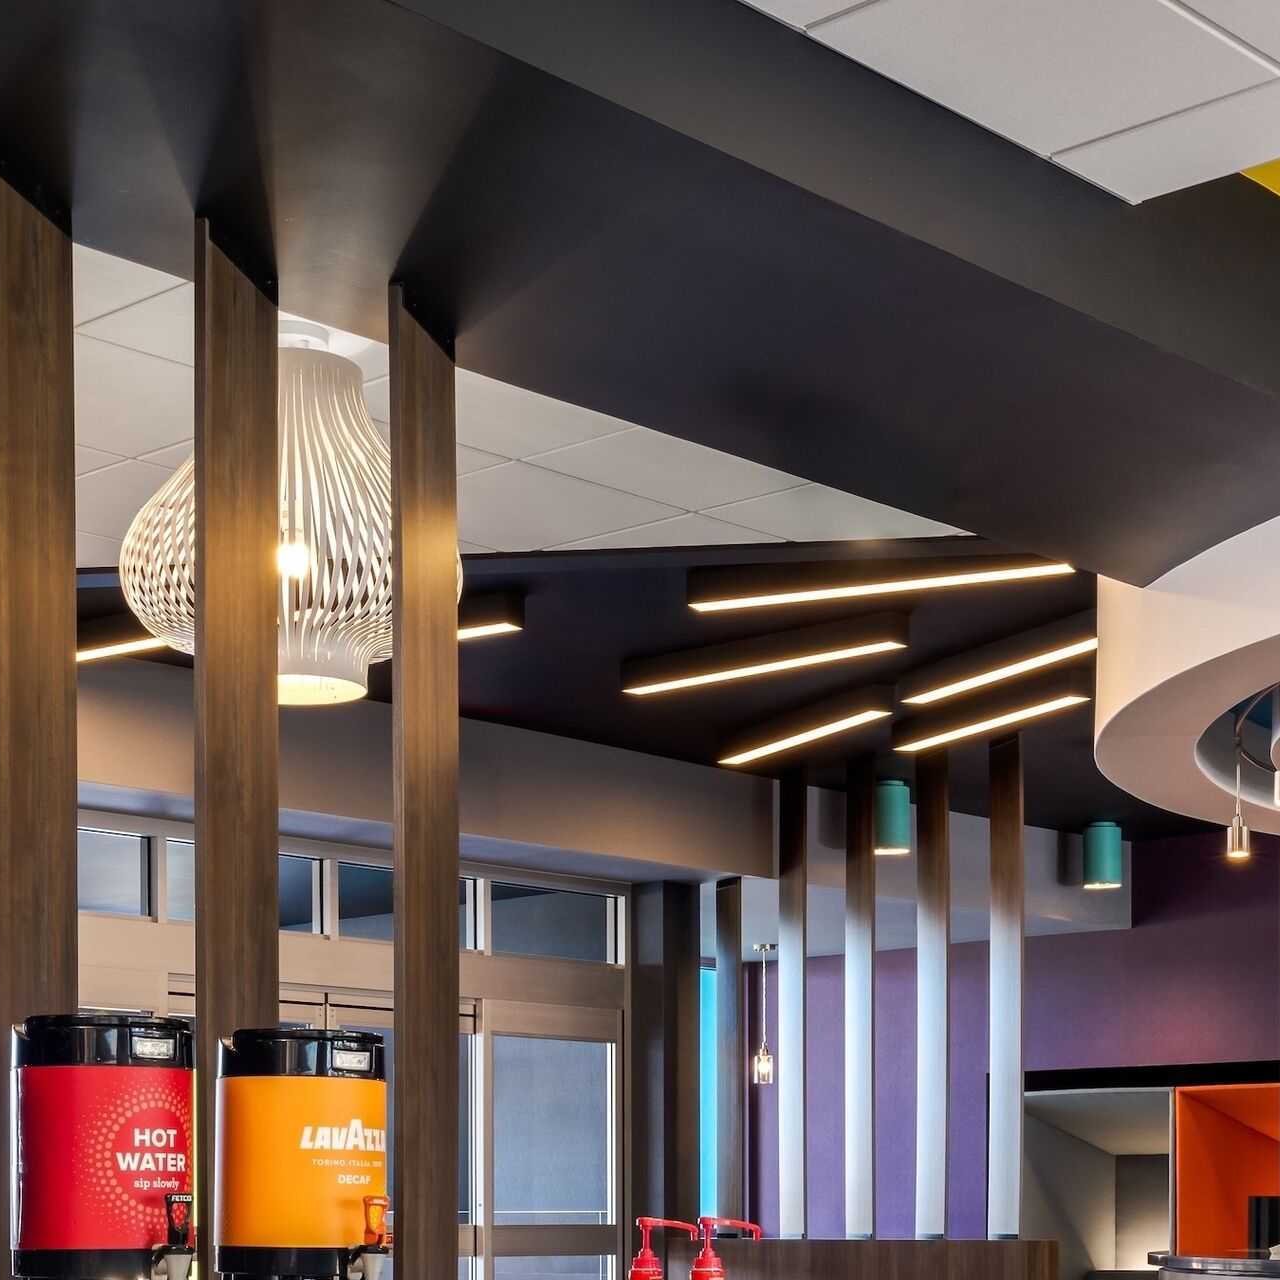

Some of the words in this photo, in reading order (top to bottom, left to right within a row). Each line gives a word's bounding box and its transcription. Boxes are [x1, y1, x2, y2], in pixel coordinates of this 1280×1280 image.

[134, 1128, 177, 1148] HOT
[116, 1152, 186, 1172] WATER
[134, 1177, 151, 1191] sip
[152, 1176, 180, 1190] slowly
[337, 1175, 371, 1185] DECAF
